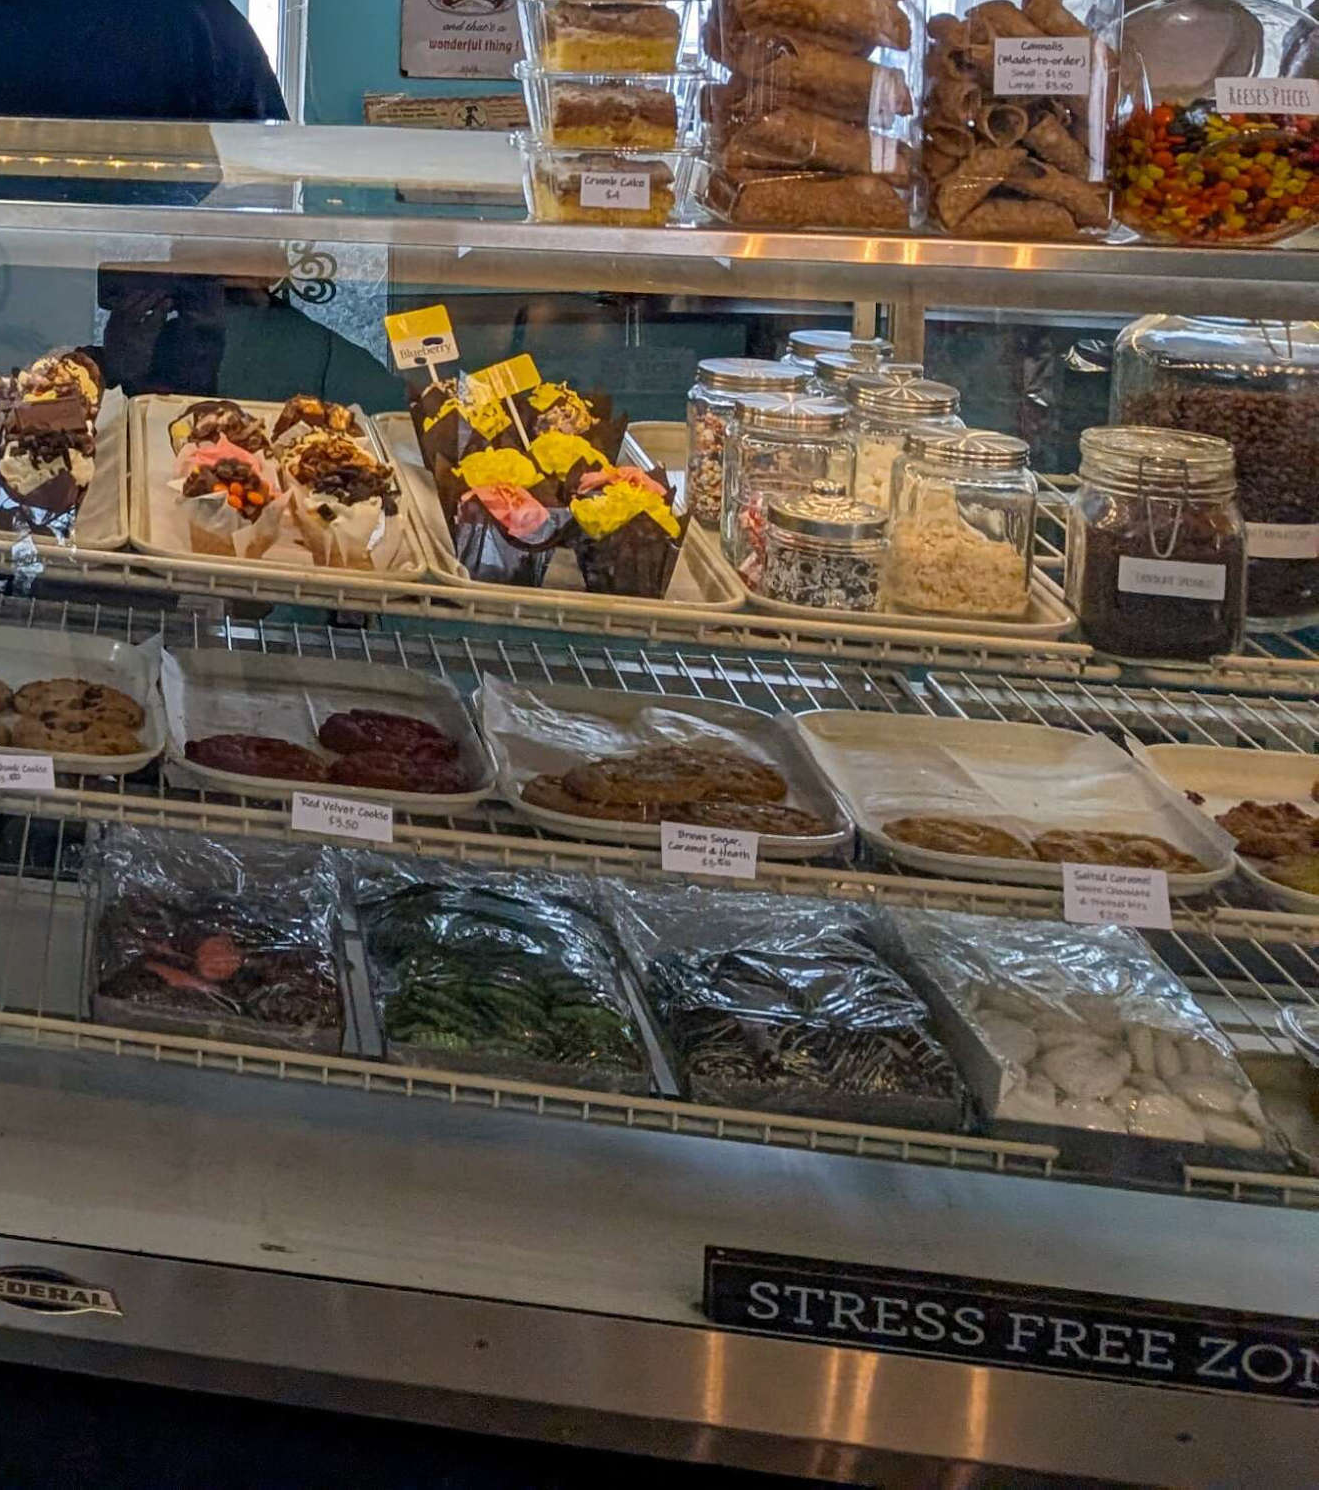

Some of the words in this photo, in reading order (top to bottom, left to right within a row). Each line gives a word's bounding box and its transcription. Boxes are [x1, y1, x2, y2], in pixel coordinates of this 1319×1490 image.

[442, 21, 464, 31] and
[465, 20, 496, 32] that's
[429, 39, 482, 53] wonderful
[1228, 86, 1270, 107] REESES
[1272, 87, 1311, 107] PIECES
[584, 176, 617, 186] Crumb
[620, 177, 645, 187] Cake
[399, 342, 452, 360] Blueberry
[301, 796, 320, 808] Red
[322, 801, 355, 815] Velvet
[357, 808, 389, 821] Cookie
[747, 1280, 986, 1347] STRESS
[1005, 1313, 1176, 1372] FREE
